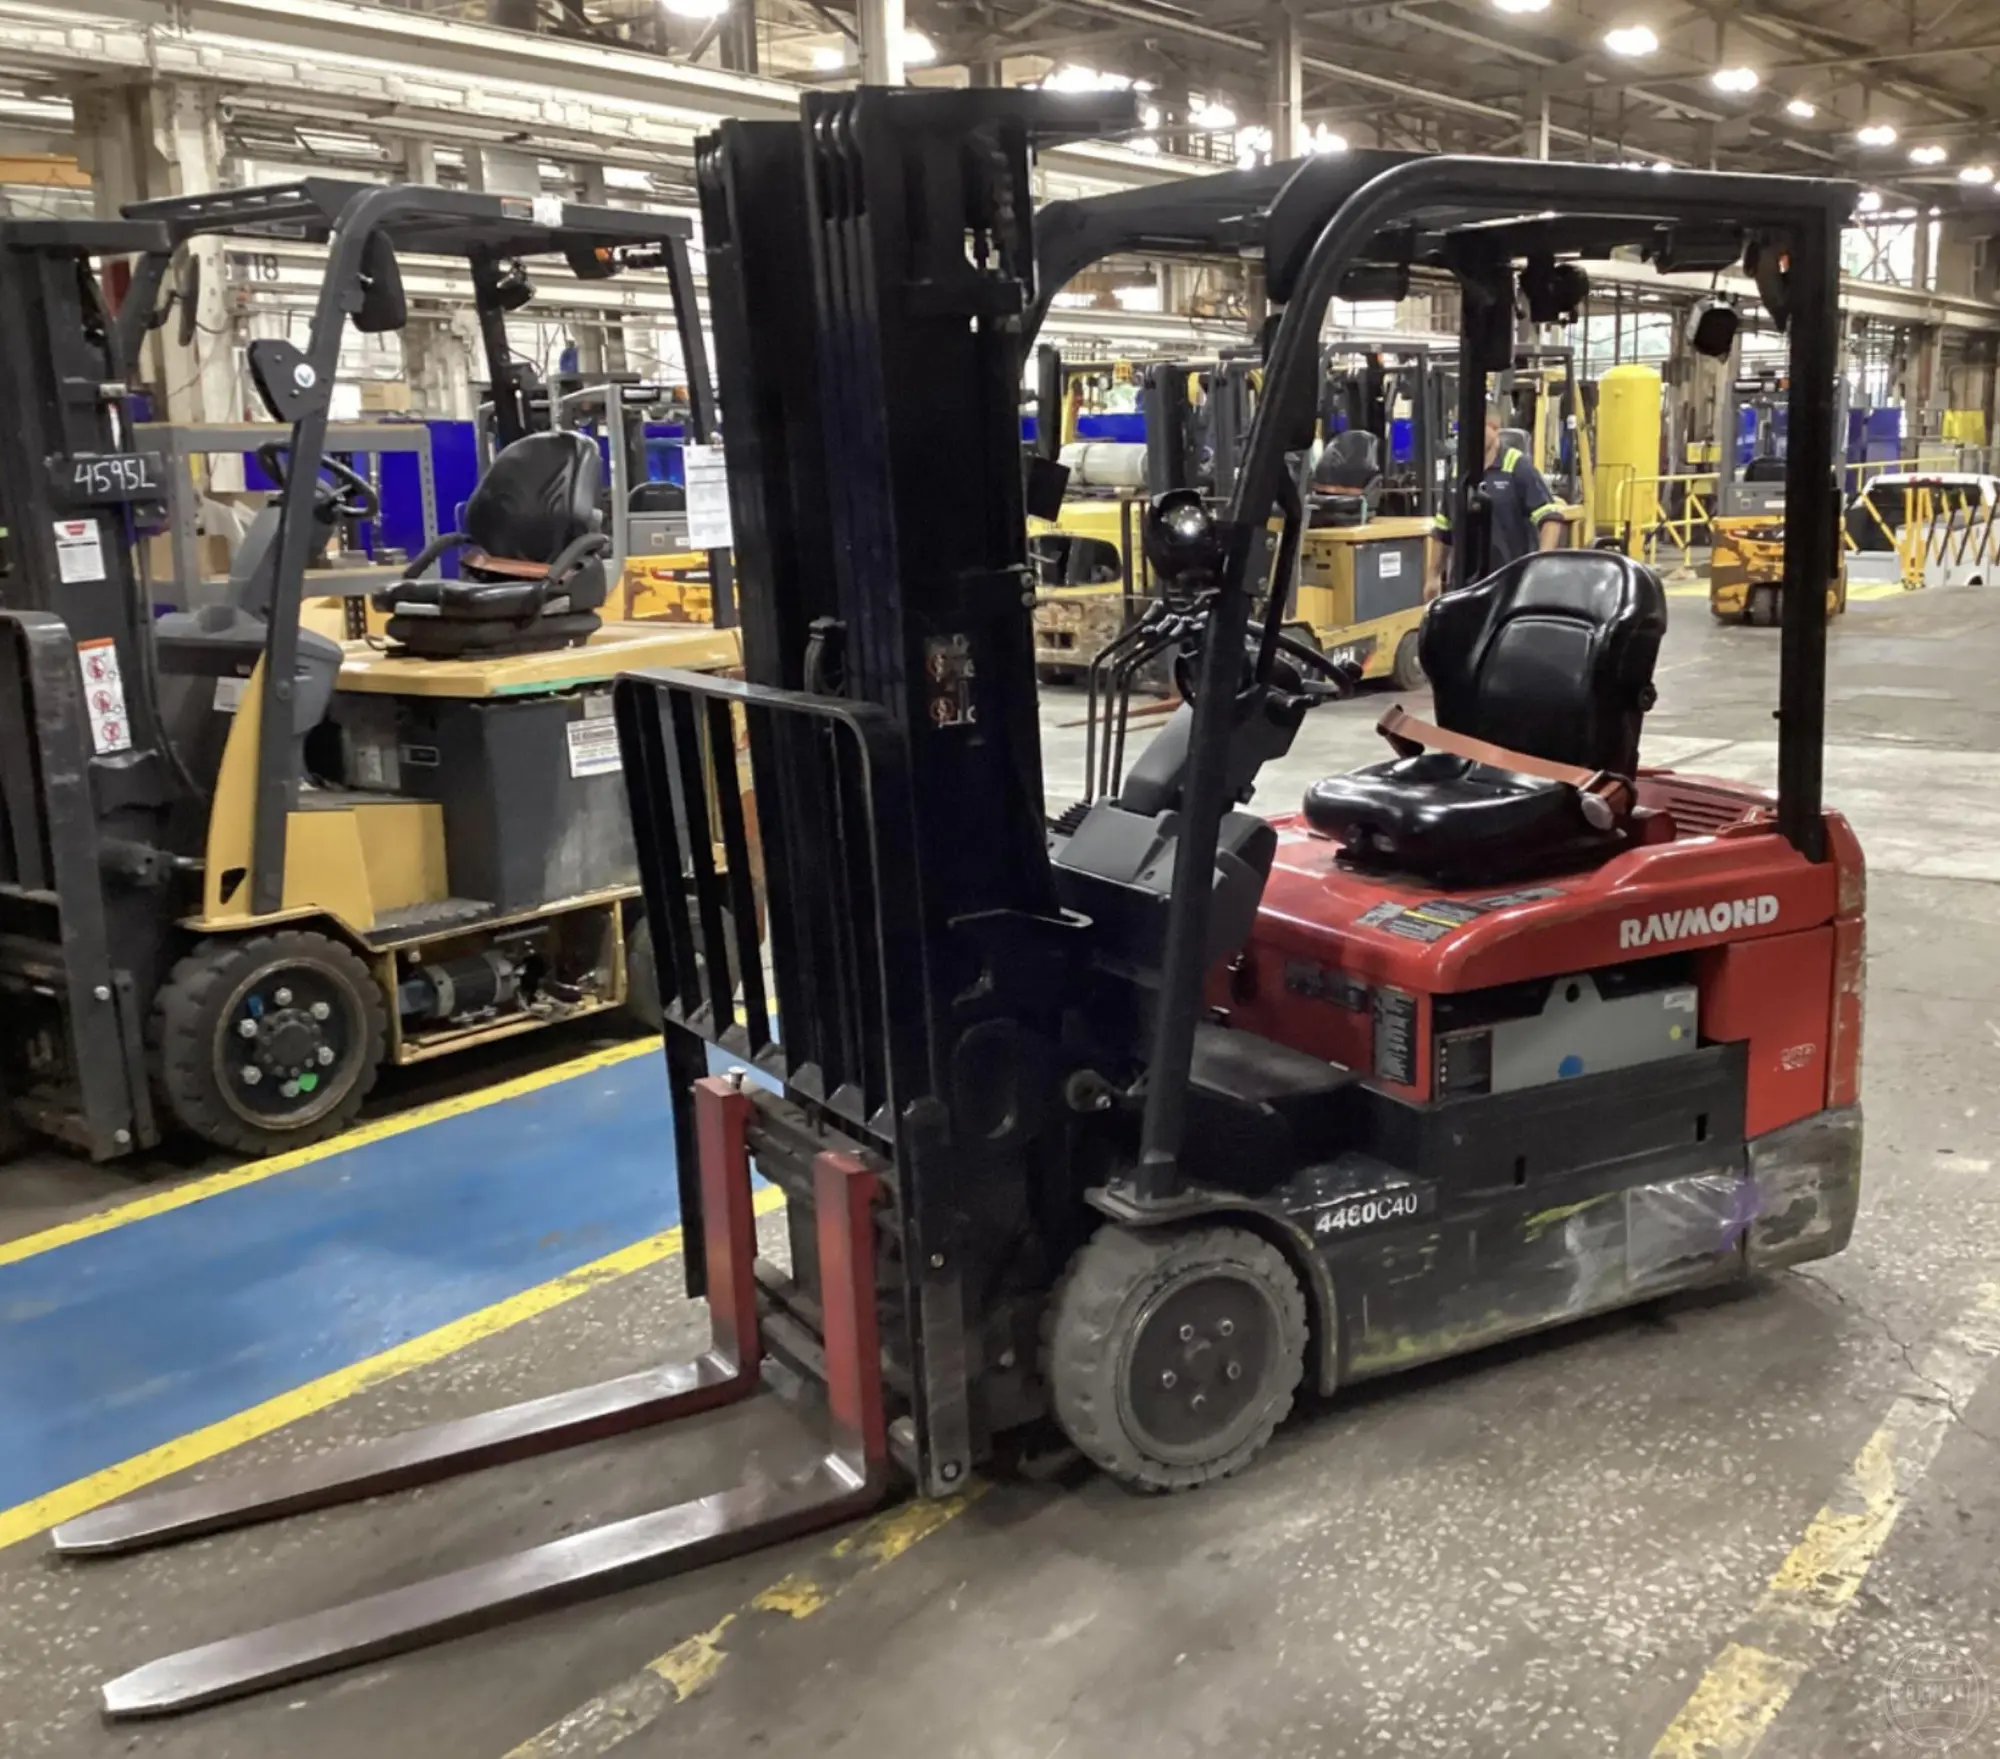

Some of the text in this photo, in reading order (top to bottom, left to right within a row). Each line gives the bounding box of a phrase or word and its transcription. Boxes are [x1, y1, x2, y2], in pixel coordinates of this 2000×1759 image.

[254, 252, 280, 281] 18
[74, 458, 157, 495] 4595L
[1619, 894, 1780, 949] RAYMOND
[1315, 1192, 1418, 1233] 4460C40
